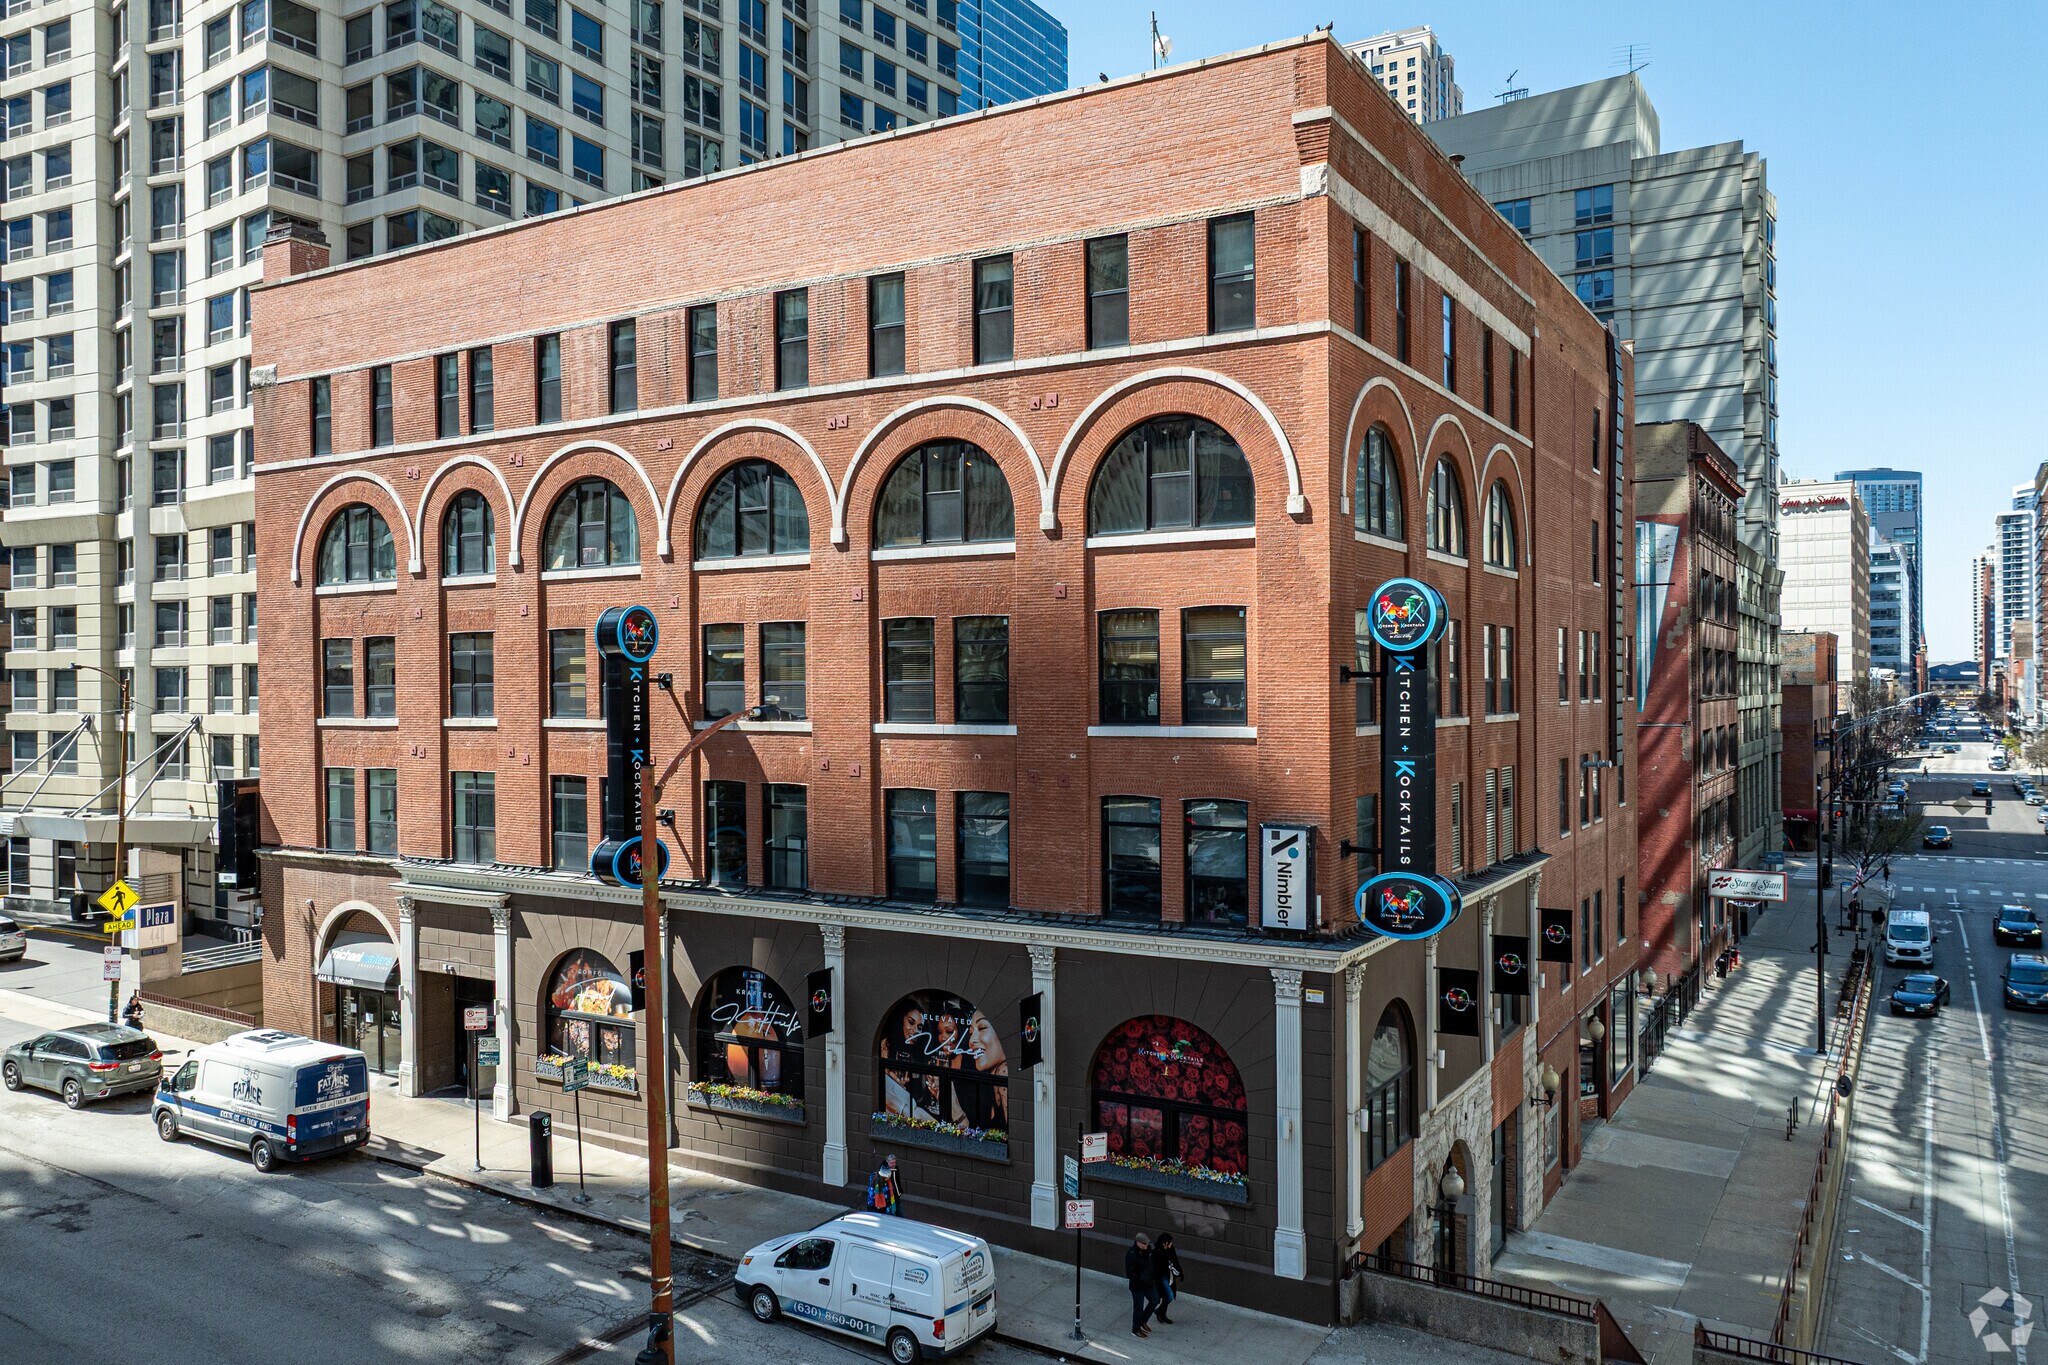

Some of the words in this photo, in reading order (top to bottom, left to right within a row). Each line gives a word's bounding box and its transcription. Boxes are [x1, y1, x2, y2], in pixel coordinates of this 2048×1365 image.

[1816, 495, 1845, 506] Suites
[629, 667, 643, 731] KITCHEN
[1393, 655, 1415, 737] KITCHEN
[630, 749, 643, 831] KOCKTAILS
[1393, 760, 1416, 865] KOCKTAILS
[1729, 877, 1751, 889] Star
[1751, 880, 1759, 890] of
[1758, 878, 1782, 892] Siam
[1277, 862, 1292, 927] Nimbler
[107, 921, 132, 931] AHEAD
[146, 908, 170, 926] Plaza
[150, 926, 165, 943] 440
[735, 988, 773, 999] KRAFTED
[923, 1013, 972, 1025] ELEVATED
[904, 1028, 986, 1059] Vibes
[317, 1077, 332, 1094] FAT
[336, 1073, 350, 1088] ICE
[233, 1081, 246, 1099] FAT
[250, 1085, 262, 1106] ICE
[905, 1269, 925, 1277] ALLIANCE
[961, 1257, 981, 1271] ALLIANCE
[793, 1301, 823, 1320] (630)
[825, 1311, 877, 1335] 860-0011
